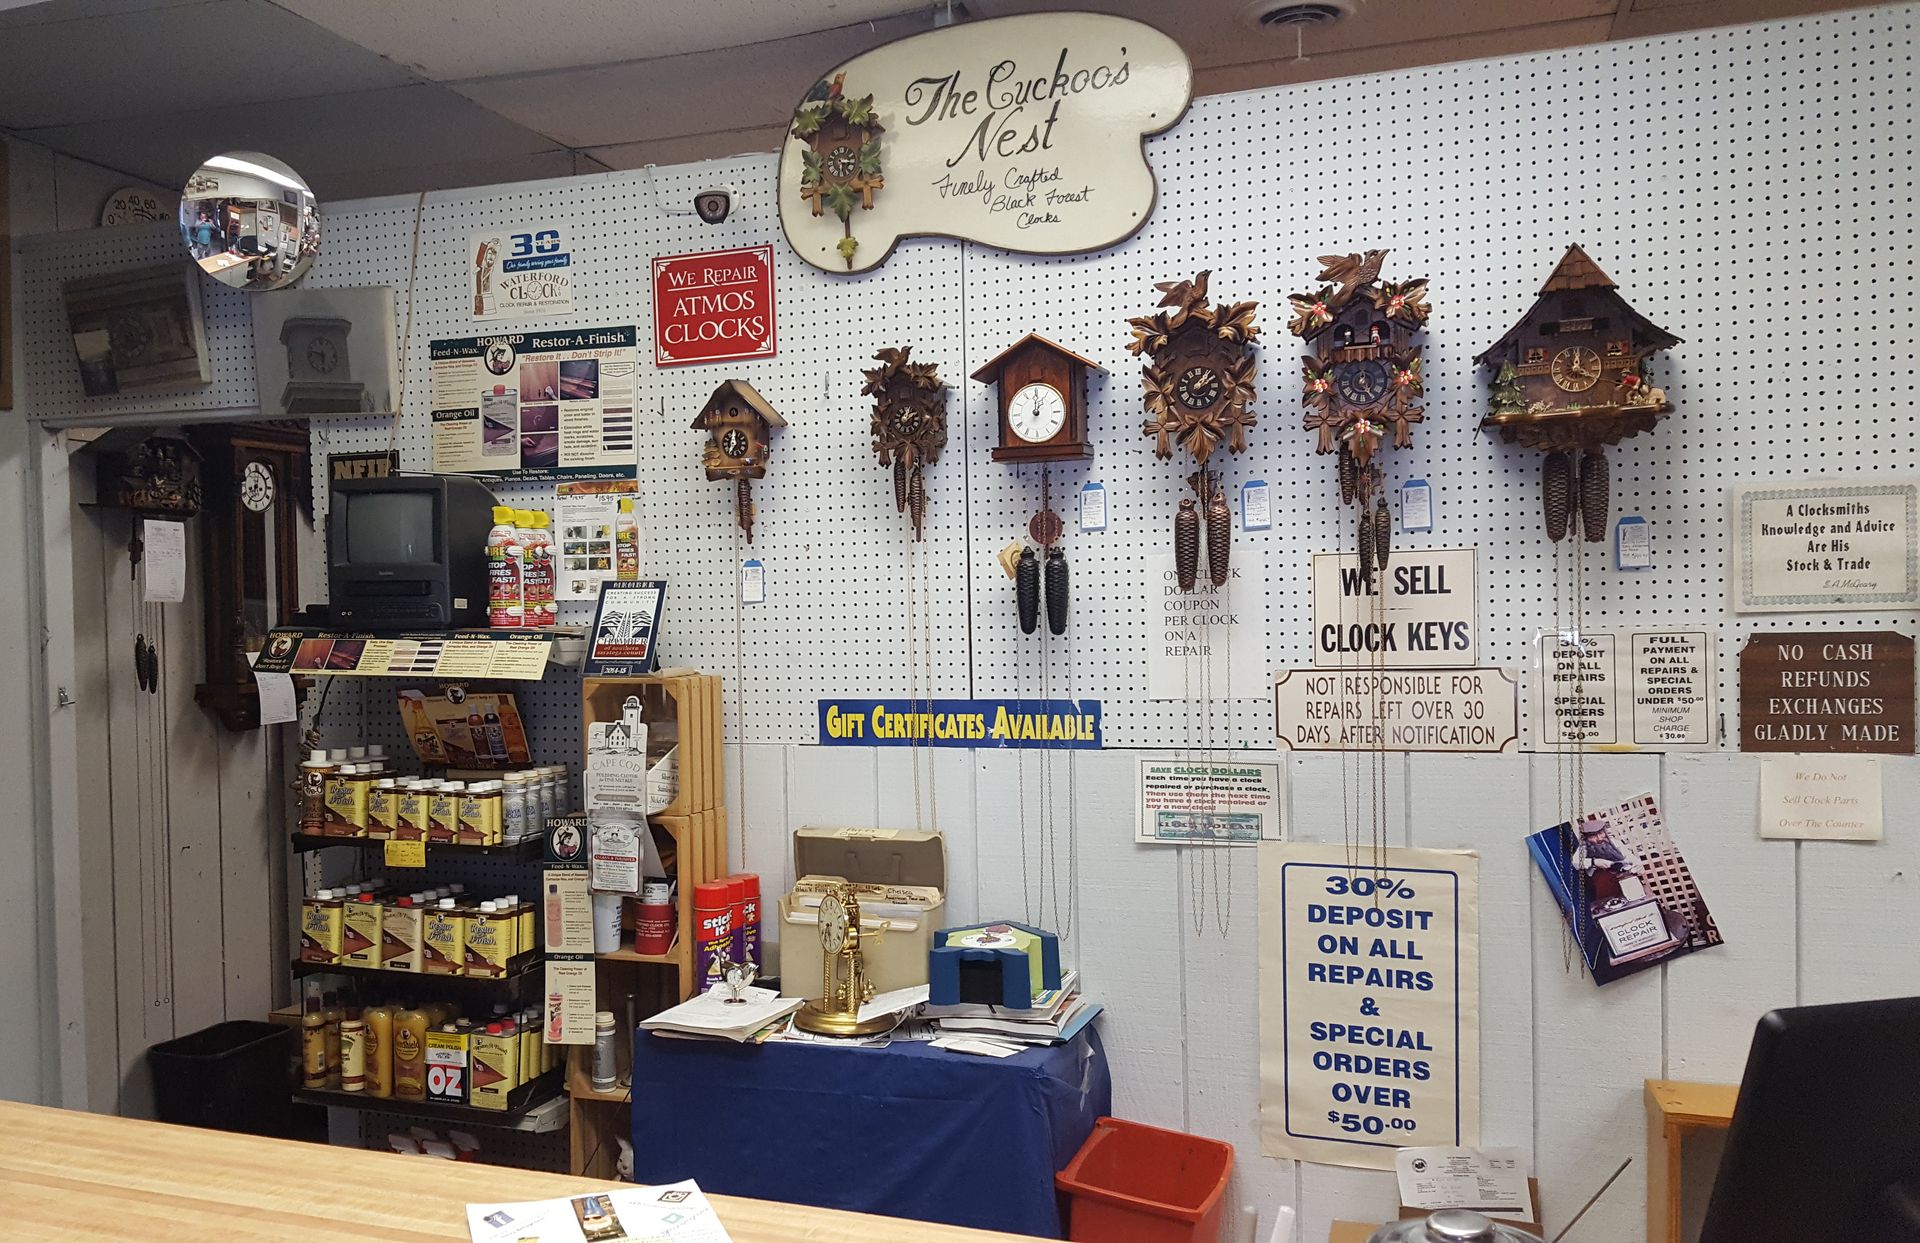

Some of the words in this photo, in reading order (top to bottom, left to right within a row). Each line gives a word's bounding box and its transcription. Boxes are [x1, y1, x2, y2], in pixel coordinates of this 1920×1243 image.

[905, 70, 977, 126] The
[985, 47, 1131, 110] Cuckoo's
[946, 99, 1062, 168] Nest
[932, 171, 996, 204] Finely
[1004, 167, 1063, 196] Crafted
[990, 194, 1035, 215] Black
[1045, 188, 1095, 205] Forest
[1016, 211, 1062, 230] Clocks
[511, 230, 559, 256] 30
[500, 272, 569, 291] WATERFORD
[703, 264, 758, 287] REPAIR
[673, 290, 755, 318] ATMOS
[664, 316, 765, 346] CLOCKS
[476, 334, 525, 347] HOWARD
[532, 332, 625, 349] Restor-A-Finish
[594, 350, 612, 358] Strip
[436, 411, 463, 420] Orange
[463, 409, 475, 417] Oil
[1786, 504, 1794, 517] A
[1798, 502, 1871, 517] Clocksmiths
[1761, 522, 1826, 538] Knowledge
[1830, 521, 1851, 533] and
[1855, 520, 1896, 533] Advice
[1807, 540, 1828, 553] Are
[1831, 539, 1850, 552] His
[1786, 558, 1820, 571] Stock
[1823, 559, 1833, 571] &
[1837, 557, 1871, 571] Trade
[1393, 565, 1451, 595] SELL
[1164, 599, 1220, 611] COUPON
[1164, 615, 1189, 626] PER
[1192, 614, 1239, 625] CLOCK
[269, 632, 303, 640] HOWARD
[509, 633, 529, 641] Orange
[1164, 630, 1184, 641] ON
[1186, 631, 1196, 641] A
[1321, 622, 1398, 653] CLOCK
[1407, 621, 1470, 652] KEYS
[1649, 636, 1690, 644] FULL
[1165, 646, 1212, 656] REPAIR
[1552, 650, 1605, 659] DEPOSIT
[1643, 646, 1696, 654] PAYMENT
[1778, 644, 1804, 660] NO
[1822, 643, 1873, 660] CASH
[1557, 662, 1575, 670] ON
[1578, 662, 1601, 670] ALL
[1669, 656, 1690, 664] ALL
[1552, 673, 1606, 682] REPAIRS
[1640, 667, 1687, 675] REPAIRS
[1306, 677, 1336, 696] NOT
[1345, 676, 1442, 695] RESPONSIBLE
[1451, 675, 1483, 695] FOR
[1647, 677, 1693, 685] SPECIAL
[1781, 671, 1871, 688] REFUNDS
[1648, 687, 1693, 695] ORDERS
[1554, 697, 1606, 705] SPECIAL
[1637, 697, 1674, 705] UNDER
[1677, 696, 1704, 705] $50.00
[1769, 698, 1884, 715] EXCHANGES
[1306, 701, 1362, 720] REPAIRS
[1371, 701, 1403, 720] LEFT
[1411, 701, 1454, 720] OVER
[1463, 701, 1485, 720] 30
[1555, 708, 1605, 717] ORDERS
[826, 705, 865, 739] GIFT
[871, 705, 984, 740] CERTIFICATES
[992, 705, 1095, 741] AVAILABLE
[1563, 720, 1597, 728] OVER
[1653, 724, 1690, 732] CHARGE
[1297, 725, 1331, 744] DAYS
[1339, 725, 1384, 744] AFTER
[1392, 725, 1495, 745] NOTIFICATION
[1754, 724, 1829, 741] GLADLY
[1842, 724, 1900, 742] MADE
[592, 759, 616, 771] CAPE
[618, 760, 641, 772] COD
[1173, 766, 1209, 775] CLOCK
[1795, 772, 1811, 781] We
[1812, 772, 1828, 781] Do
[1830, 772, 1848, 781] Not
[1195, 784, 1235, 792] purchase
[1782, 795, 1801, 804] Sell
[1803, 795, 1830, 805] Clock
[1833, 795, 1859, 805] Parts
[546, 818, 587, 828] HOWARD
[1779, 818, 1802, 828] Over
[1805, 818, 1823, 828] The
[1824, 818, 1865, 829] Counter
[1325, 875, 1416, 900] 30%
[1307, 903, 1434, 930] DEPOSIT
[1616, 919, 1653, 937] CLOCK
[1618, 925, 1658, 944] REPAIR
[1317, 934, 1359, 956] ON
[1369, 938, 1424, 961] ALL
[1307, 962, 1434, 992] REPAIRS
[1360, 997, 1380, 1017] &
[1309, 1021, 1433, 1052] SPECIAL
[1312, 1051, 1431, 1081] ORDERS
[428, 1066, 462, 1097] OZ
[1331, 1082, 1411, 1109] OVER
